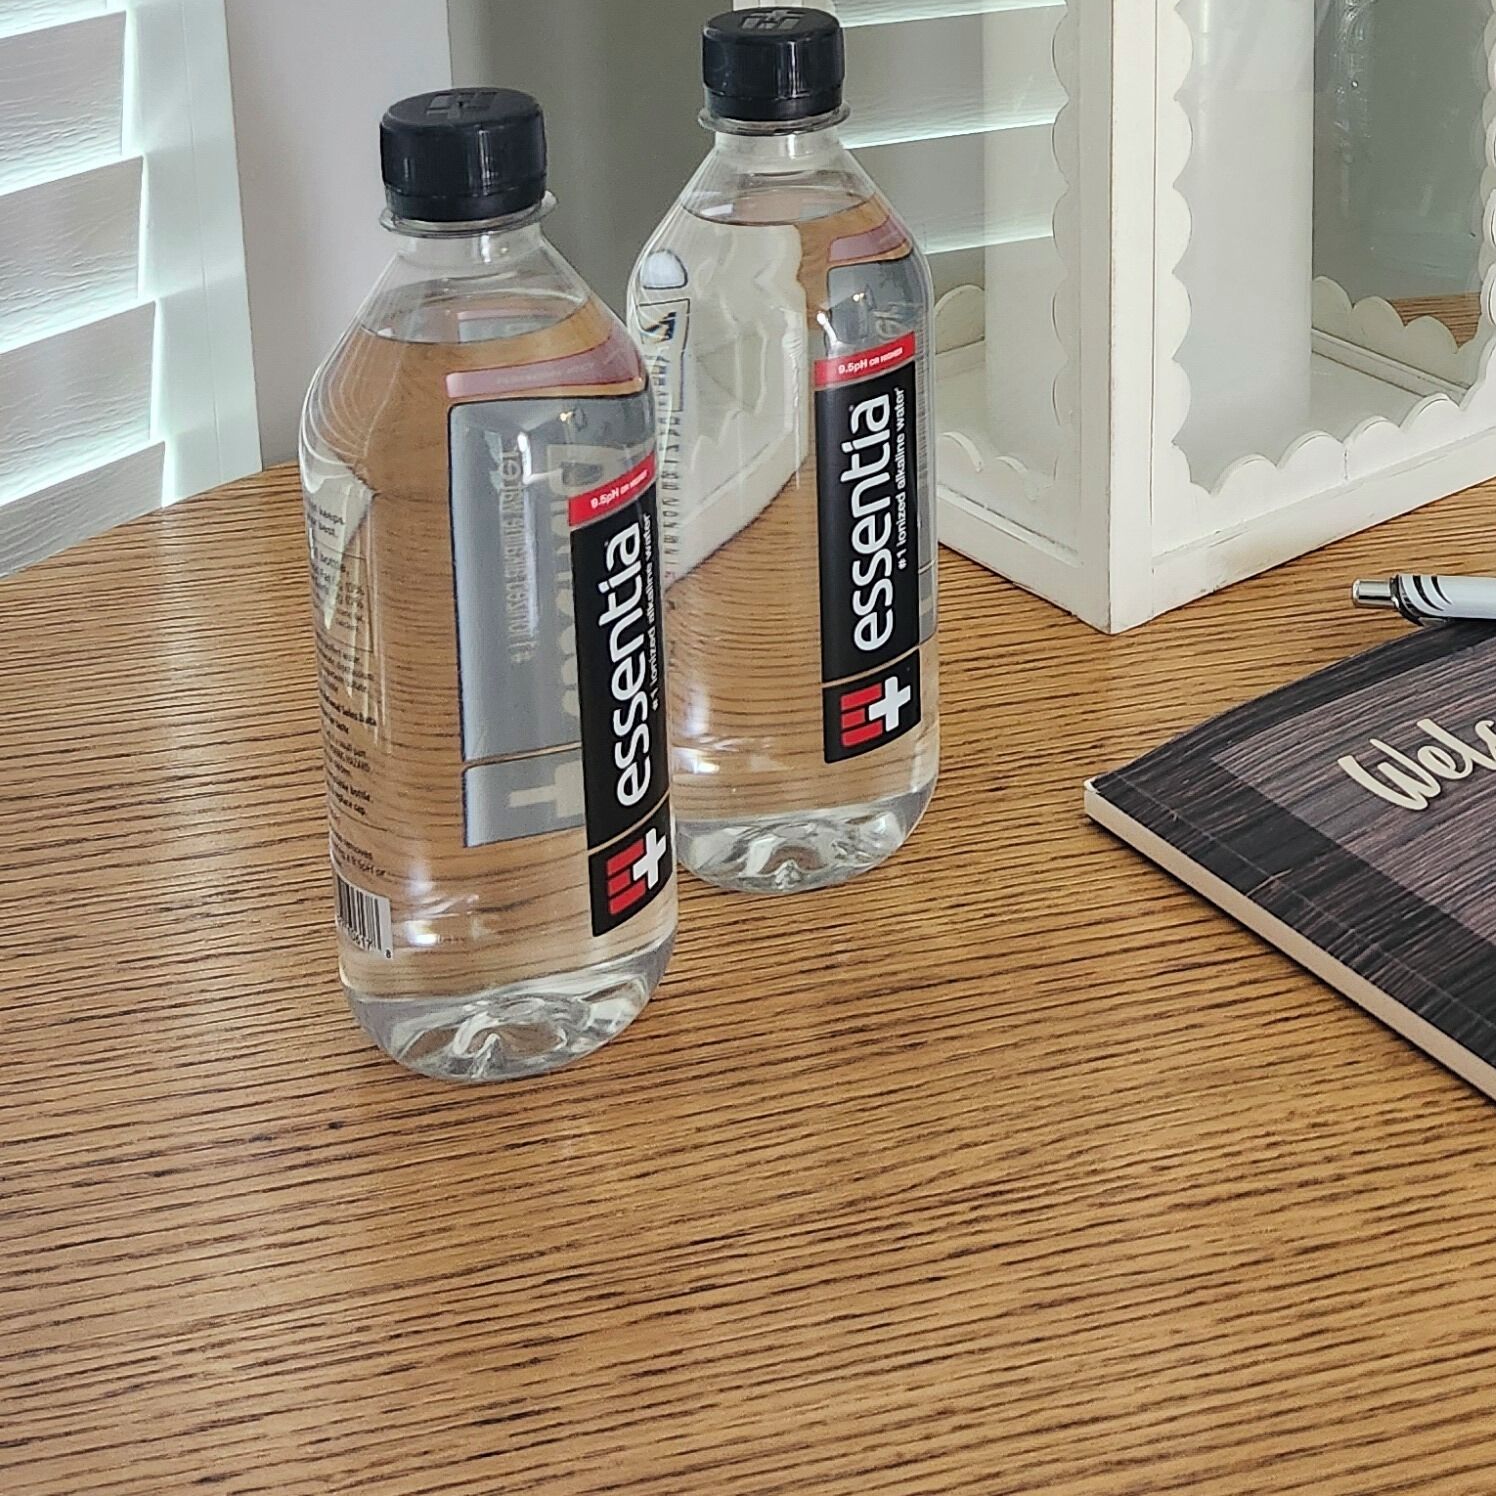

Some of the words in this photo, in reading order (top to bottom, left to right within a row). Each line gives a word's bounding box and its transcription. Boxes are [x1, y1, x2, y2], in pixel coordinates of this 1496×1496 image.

[894, 388, 906, 432] water
[895, 433, 906, 489] alkaline
[841, 393, 894, 651] essentia
[895, 491, 907, 547] ionized
[896, 548, 907, 570] #1
[598, 522, 651, 806] essentia
[647, 627, 659, 687] ionized
